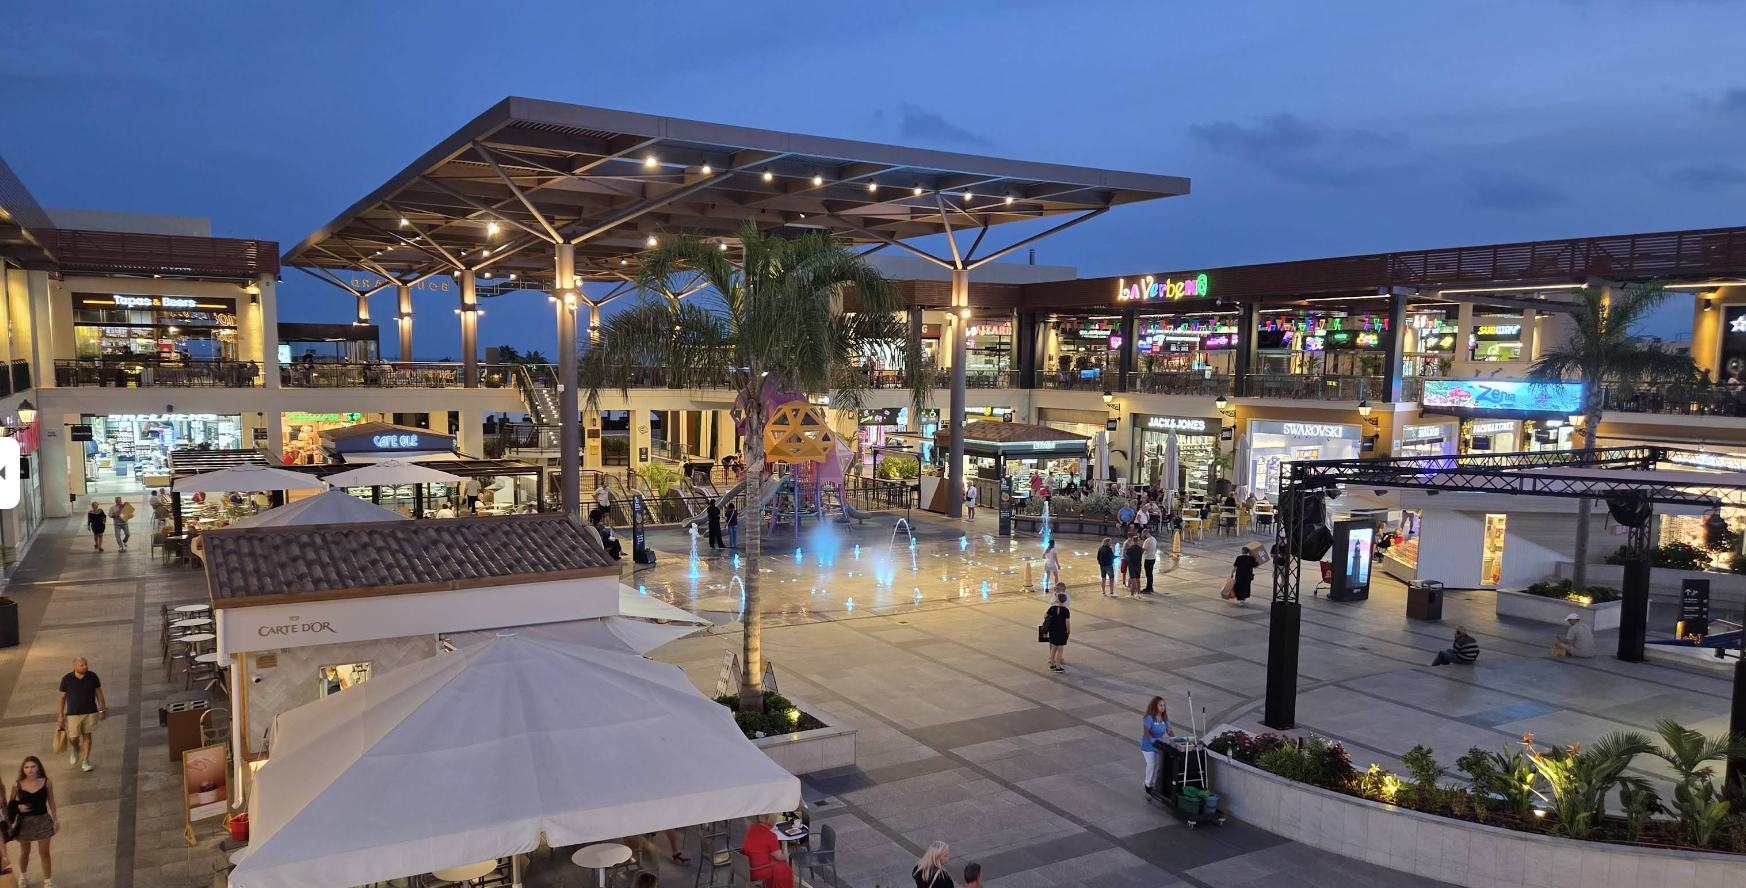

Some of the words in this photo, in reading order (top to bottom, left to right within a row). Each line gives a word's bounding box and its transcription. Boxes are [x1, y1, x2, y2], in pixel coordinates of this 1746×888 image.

[113, 294, 153, 307] Tapas
[153, 298, 161, 306] &
[162, 297, 197, 307] Beers
[1477, 325, 1521, 335] SUBWAY
[1475, 384, 1516, 403] Zenia
[1283, 423, 1343, 438] SWAROVSKI
[373, 434, 398, 447] CAFÉ
[399, 434, 419, 447] OLÉ
[258, 624, 298, 637] CARTE
